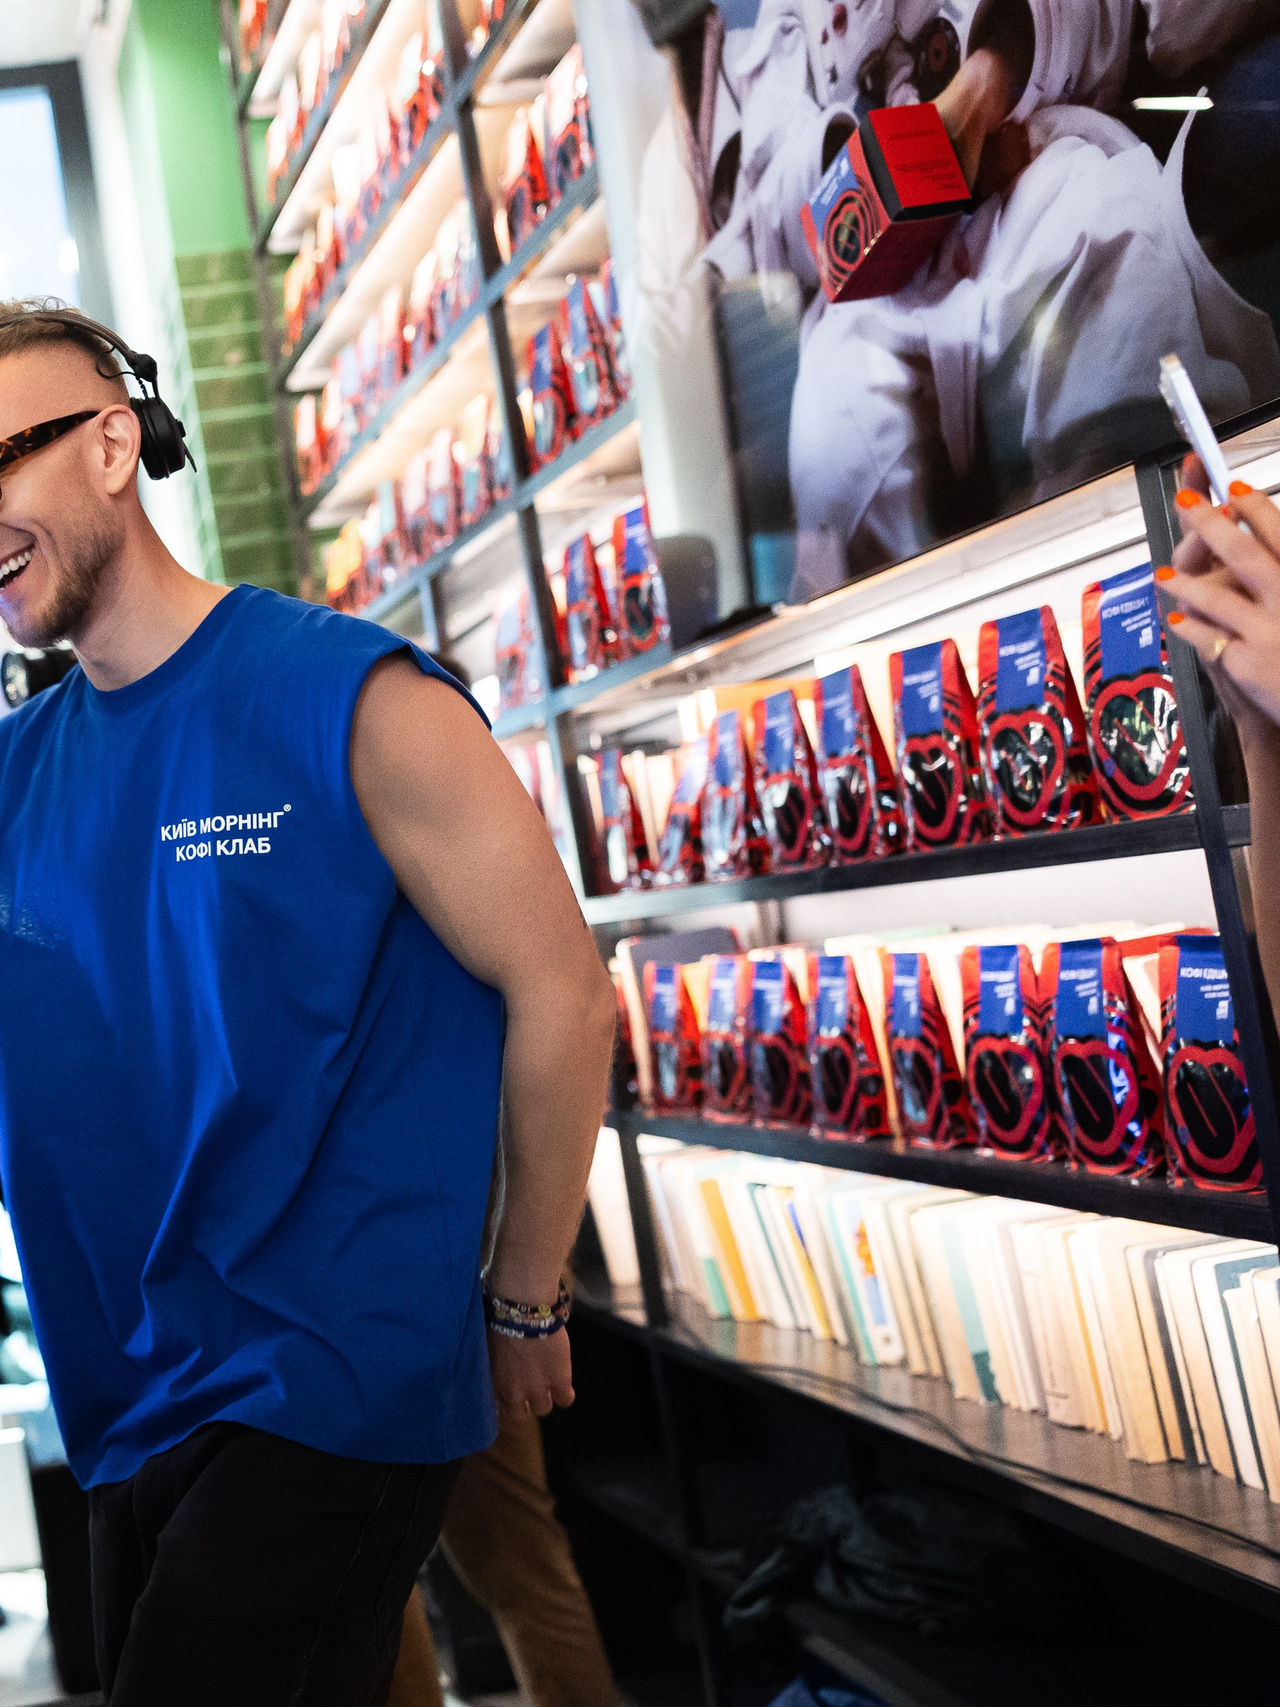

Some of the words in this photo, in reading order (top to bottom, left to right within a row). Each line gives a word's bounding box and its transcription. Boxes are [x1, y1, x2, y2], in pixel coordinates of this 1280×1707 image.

[160, 818, 197, 841] КИЇВ
[176, 841, 211, 862] КОФІ
[216, 837, 271, 856] КЛАБ
